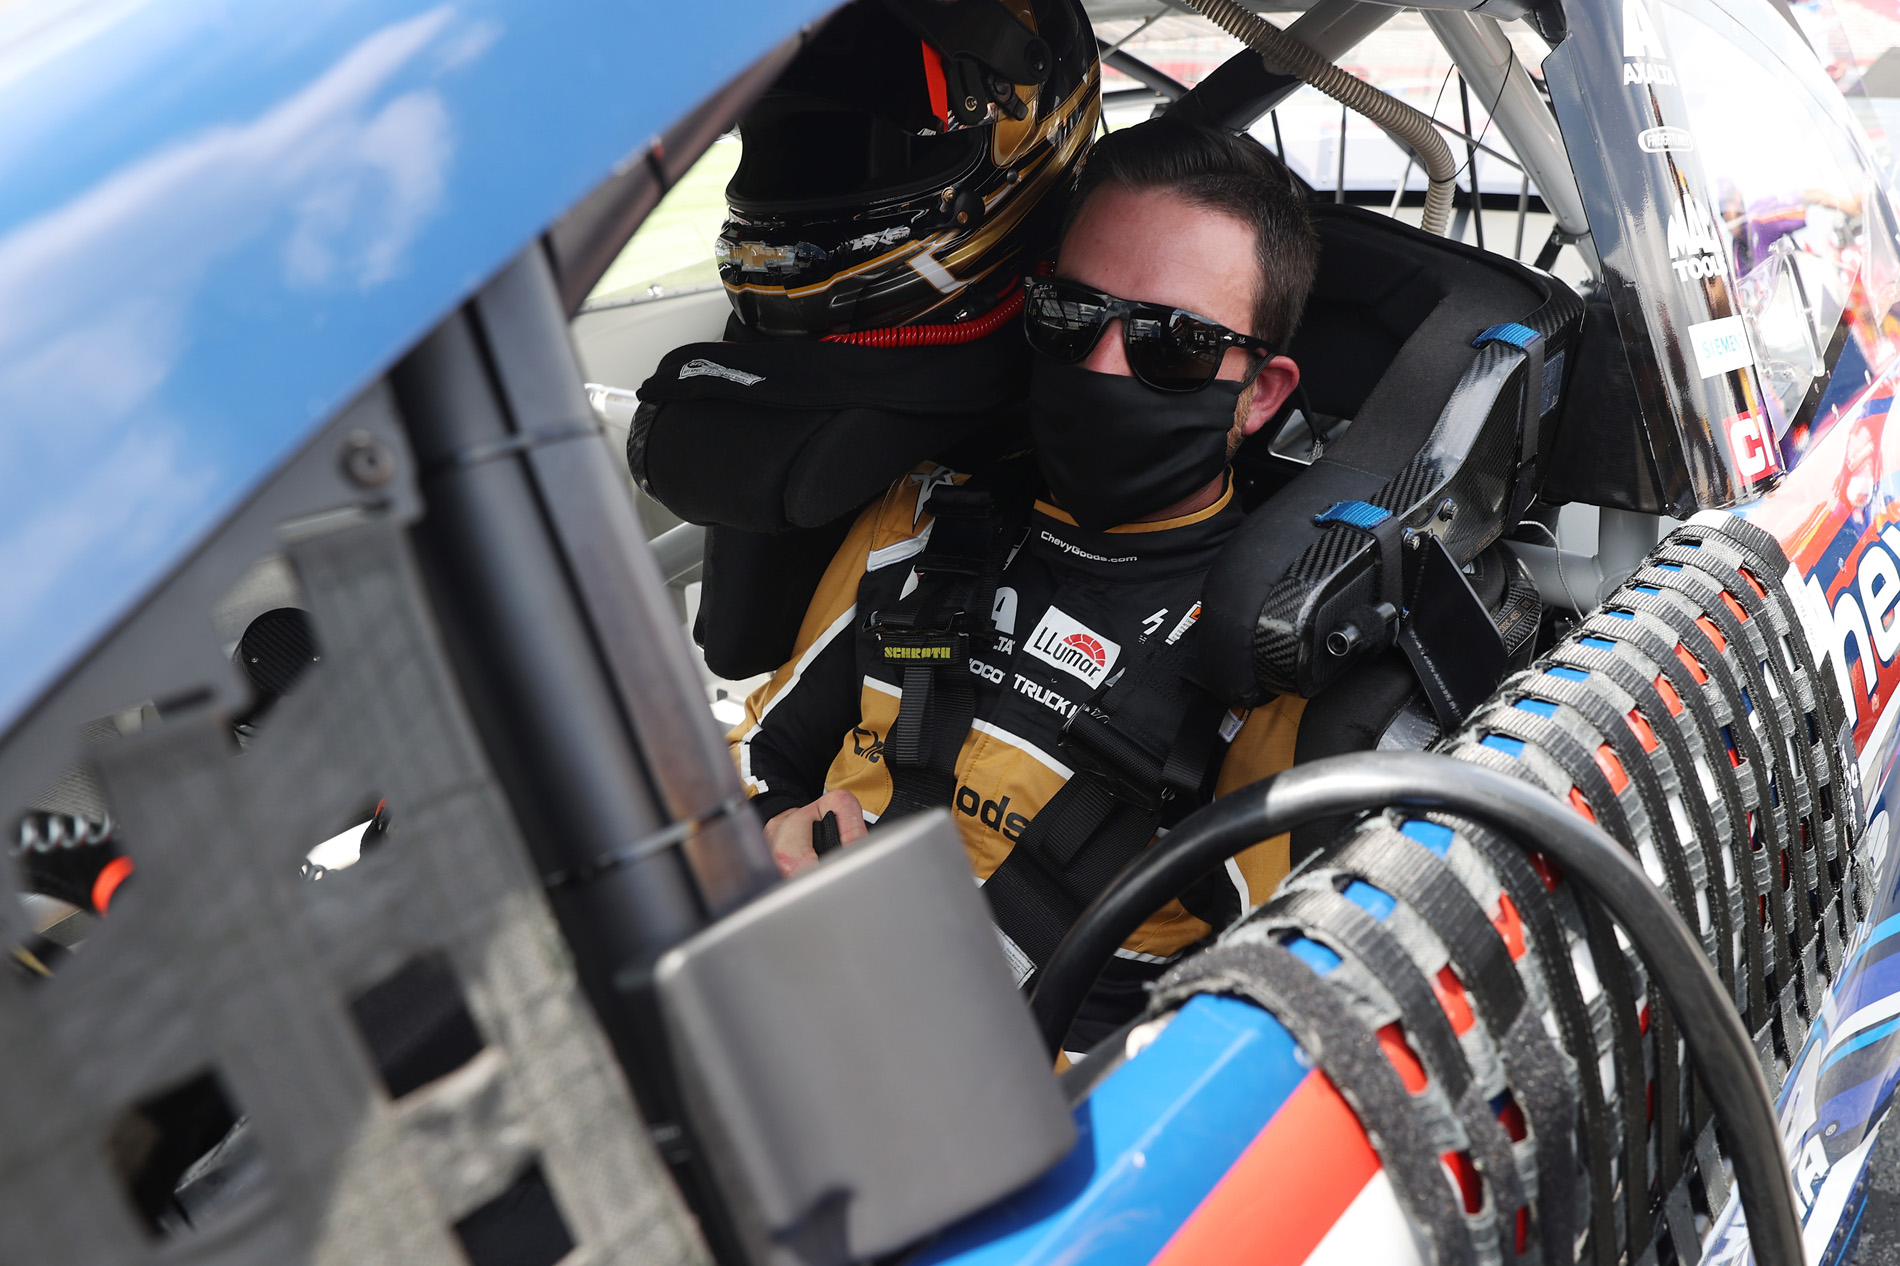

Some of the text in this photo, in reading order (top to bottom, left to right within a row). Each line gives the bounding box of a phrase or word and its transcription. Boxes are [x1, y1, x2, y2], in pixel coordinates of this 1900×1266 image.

[1622, 62, 1679, 87] AXALTA
[1671, 254, 1728, 283] TOOLS
[1040, 530, 1138, 563] ChevyGoods.com
[883, 646, 951, 659] SCHROTH
[1033, 626, 1101, 678] LLumar
[968, 657, 1005, 685] OCO
[956, 785, 1030, 843] ods
